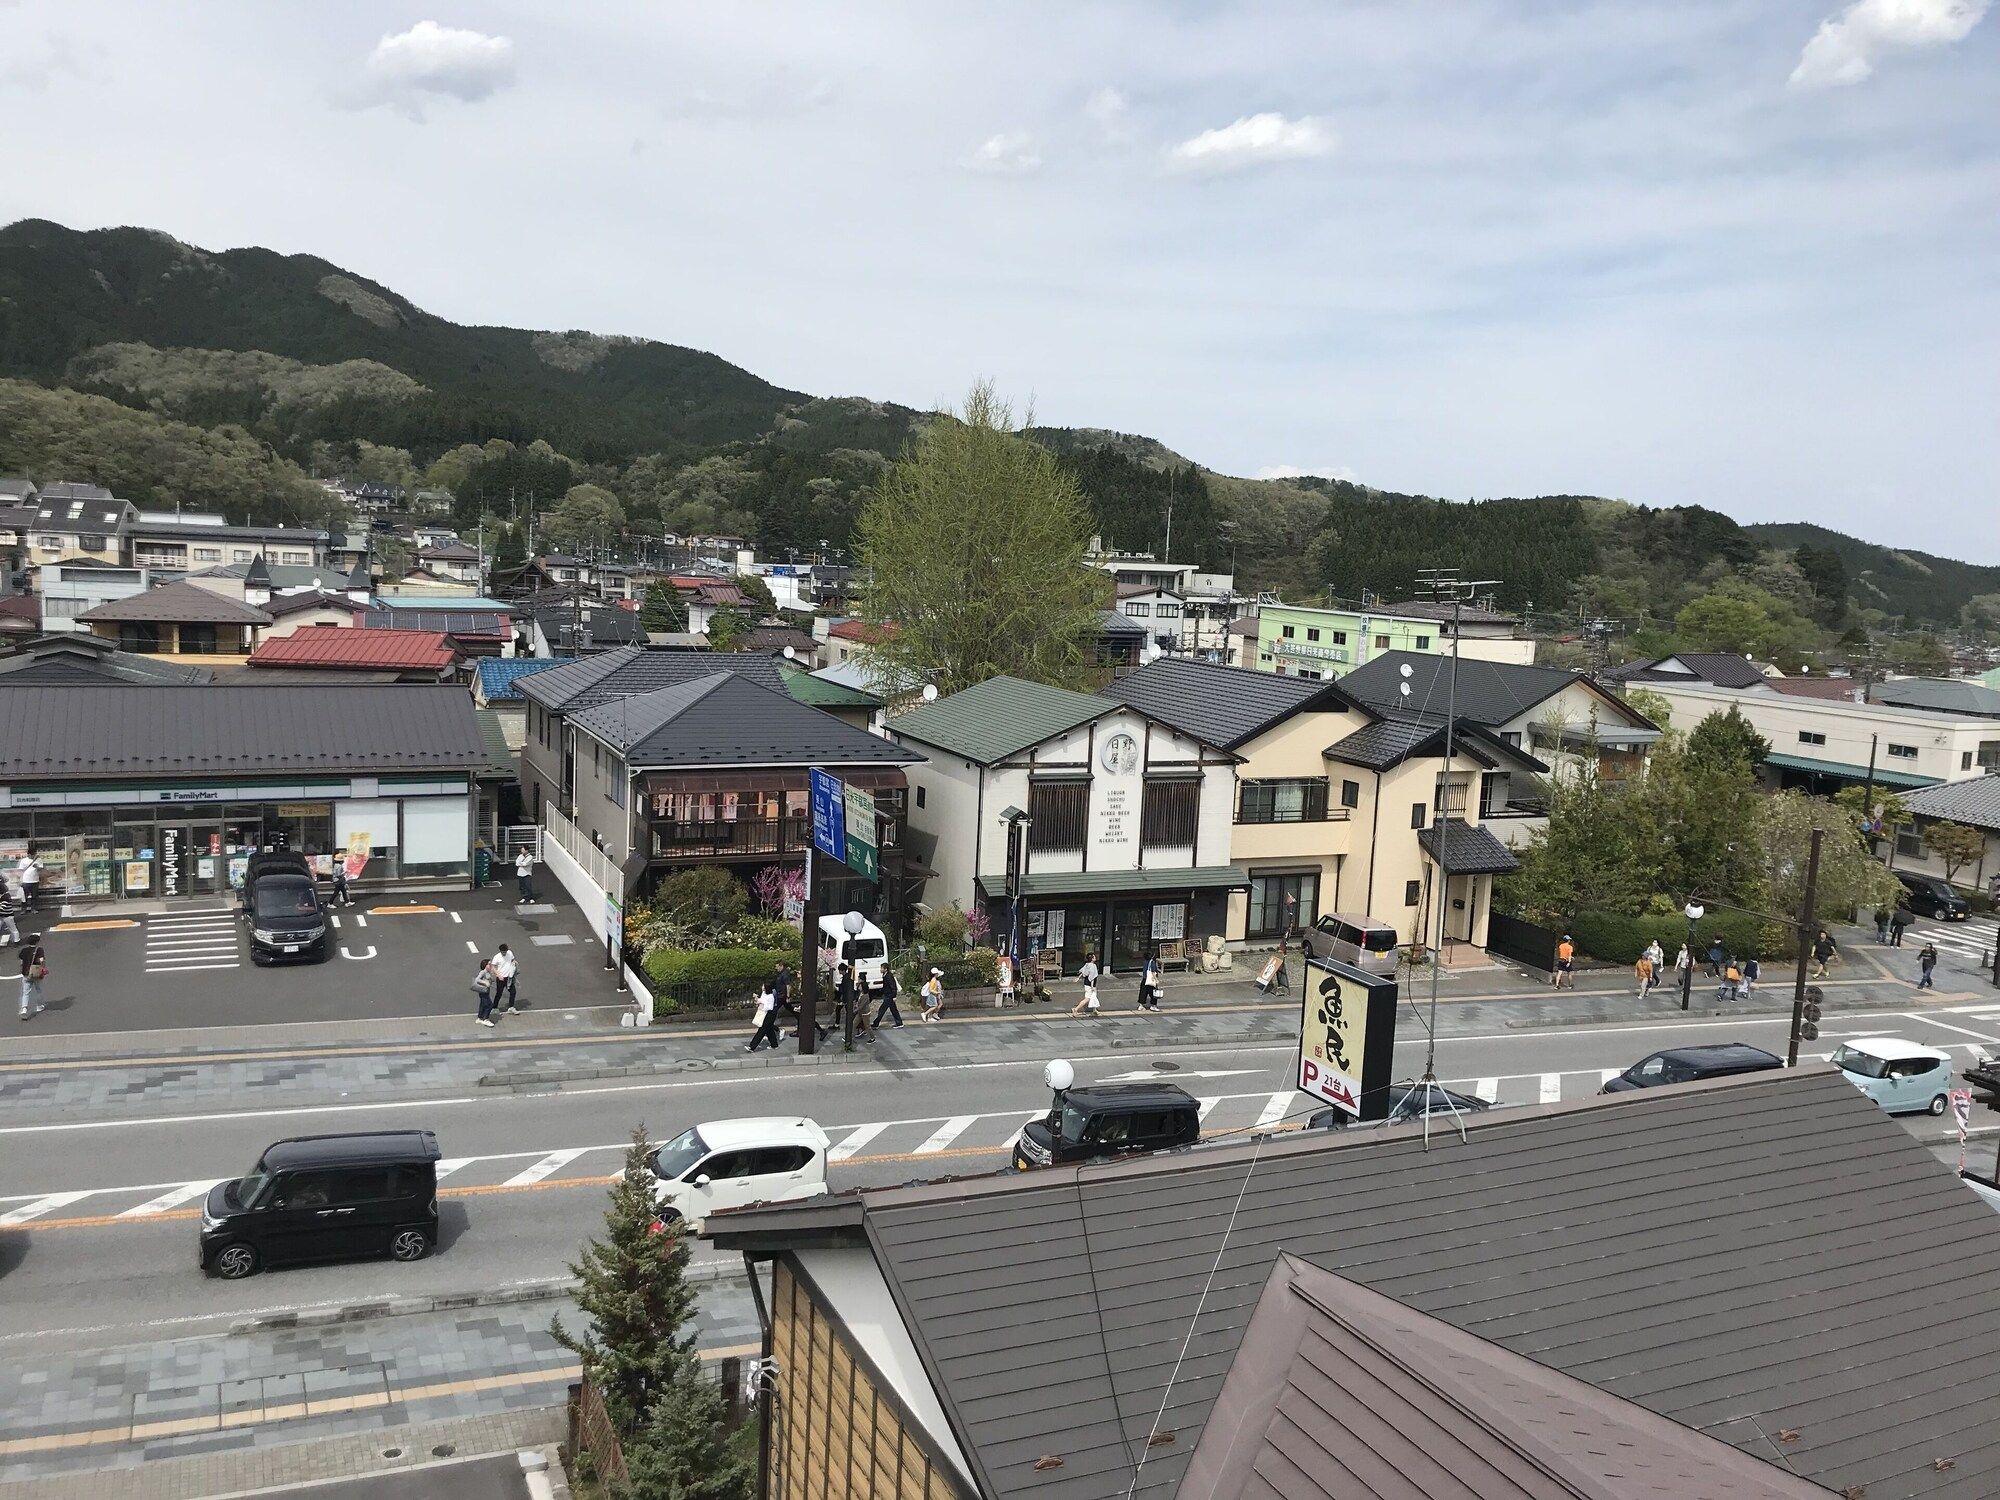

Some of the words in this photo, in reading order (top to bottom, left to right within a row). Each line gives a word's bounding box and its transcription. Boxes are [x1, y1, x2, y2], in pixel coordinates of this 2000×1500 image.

[173, 791, 218, 799] FamilyMart
[163, 829, 179, 896] FamilyMart
[1303, 1059, 1319, 1087] P
[1324, 1074, 1342, 1092] 21台
